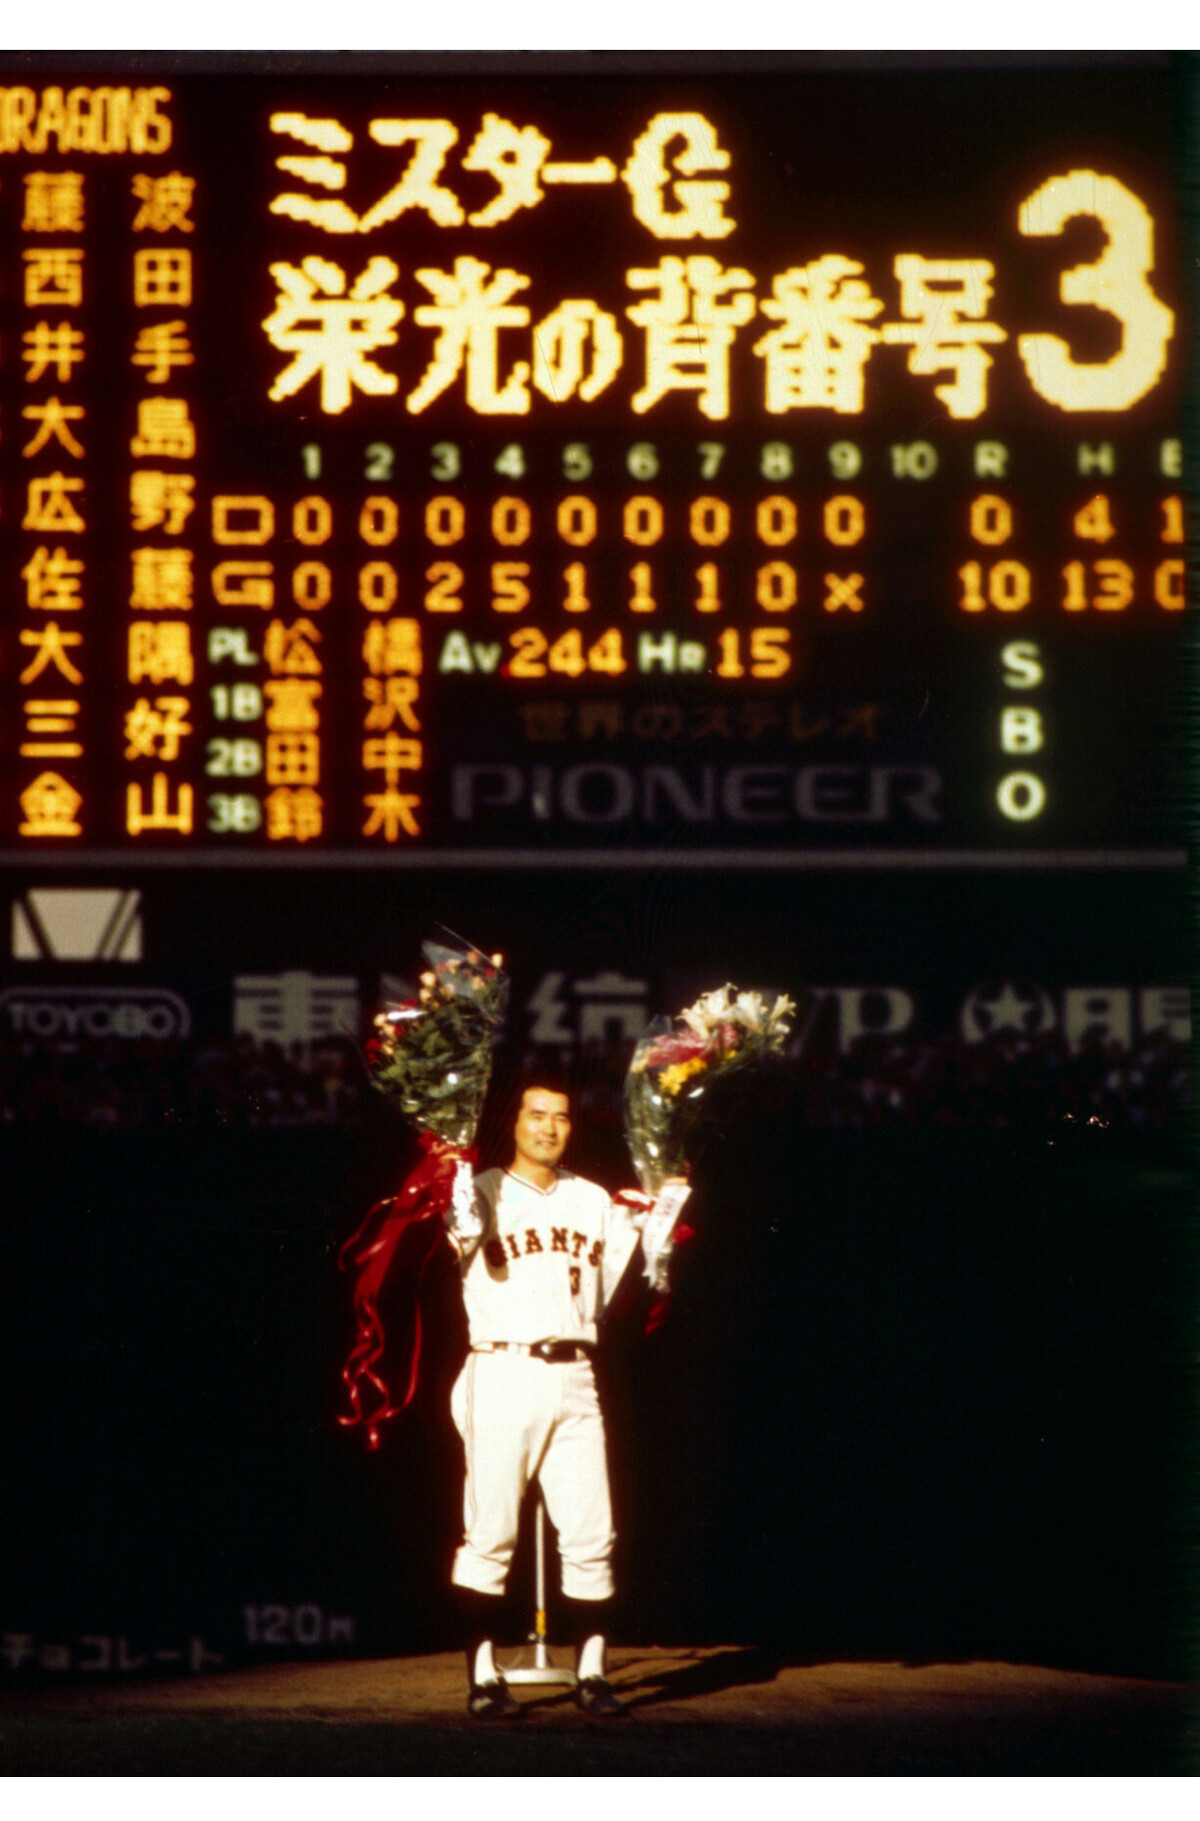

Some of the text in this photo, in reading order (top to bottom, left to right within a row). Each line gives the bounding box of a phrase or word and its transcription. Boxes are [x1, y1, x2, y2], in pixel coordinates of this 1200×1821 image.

[132, 171, 195, 232] 波
[23, 248, 192, 307] 西 田
[1018, 168, 1175, 413] 3
[22, 320, 194, 384] 井 手
[261, 253, 1008, 421] 栄光の背番号
[23, 397, 85, 458] 大
[303, 444, 322, 479] 1
[365, 442, 395, 482] 2
[432, 442, 461, 481] 3
[495, 444, 526, 479] 4
[562, 443, 593, 482] 5
[626, 443, 659, 480] 6
[699, 441, 725, 480] 7
[760, 443, 794, 481] 8
[828, 441, 863, 480] 9
[890, 440, 938, 481] 10
[973, 440, 1008, 477] R
[1077, 443, 1115, 475] H
[23, 472, 85, 533] 広
[293, 496, 332, 545] 0
[359, 496, 399, 546] 0
[425, 496, 465, 546] 0
[491, 496, 531, 546] 0
[557, 496, 597, 546] 0
[623, 496, 663, 546] 0
[690, 496, 730, 546] 0
[756, 496, 797, 546] 0
[824, 495, 865, 546] 0
[970, 494, 1012, 545] 0
[1074, 494, 1115, 543] 4
[1162, 497, 1184, 543] 1
[212, 561, 274, 610] G
[293, 561, 331, 610] 0
[359, 561, 398, 612] 0
[425, 562, 464, 612] 2
[491, 562, 530, 612] 5
[563, 562, 590, 612] 1
[629, 562, 656, 612] 1
[696, 563, 721, 612] 1
[756, 561, 797, 612] 0
[959, 560, 1030, 612] 10
[1063, 559, 1133, 611] 13
[20, 622, 82, 684] 大
[208, 627, 258, 666] PL
[717, 627, 790, 678] 15
[1002, 643, 1042, 688] S
[20, 696, 192, 761] 三 好
[211, 683, 264, 721] 1B
[1001, 708, 1042, 753] B
[206, 738, 264, 777] 2B
[20, 772, 193, 836] 金 山
[364, 789, 420, 842] 木
[450, 763, 942, 823] PIONEER
[997, 772, 1045, 820] O
[8, 1002, 175, 1039] TOYOBO
